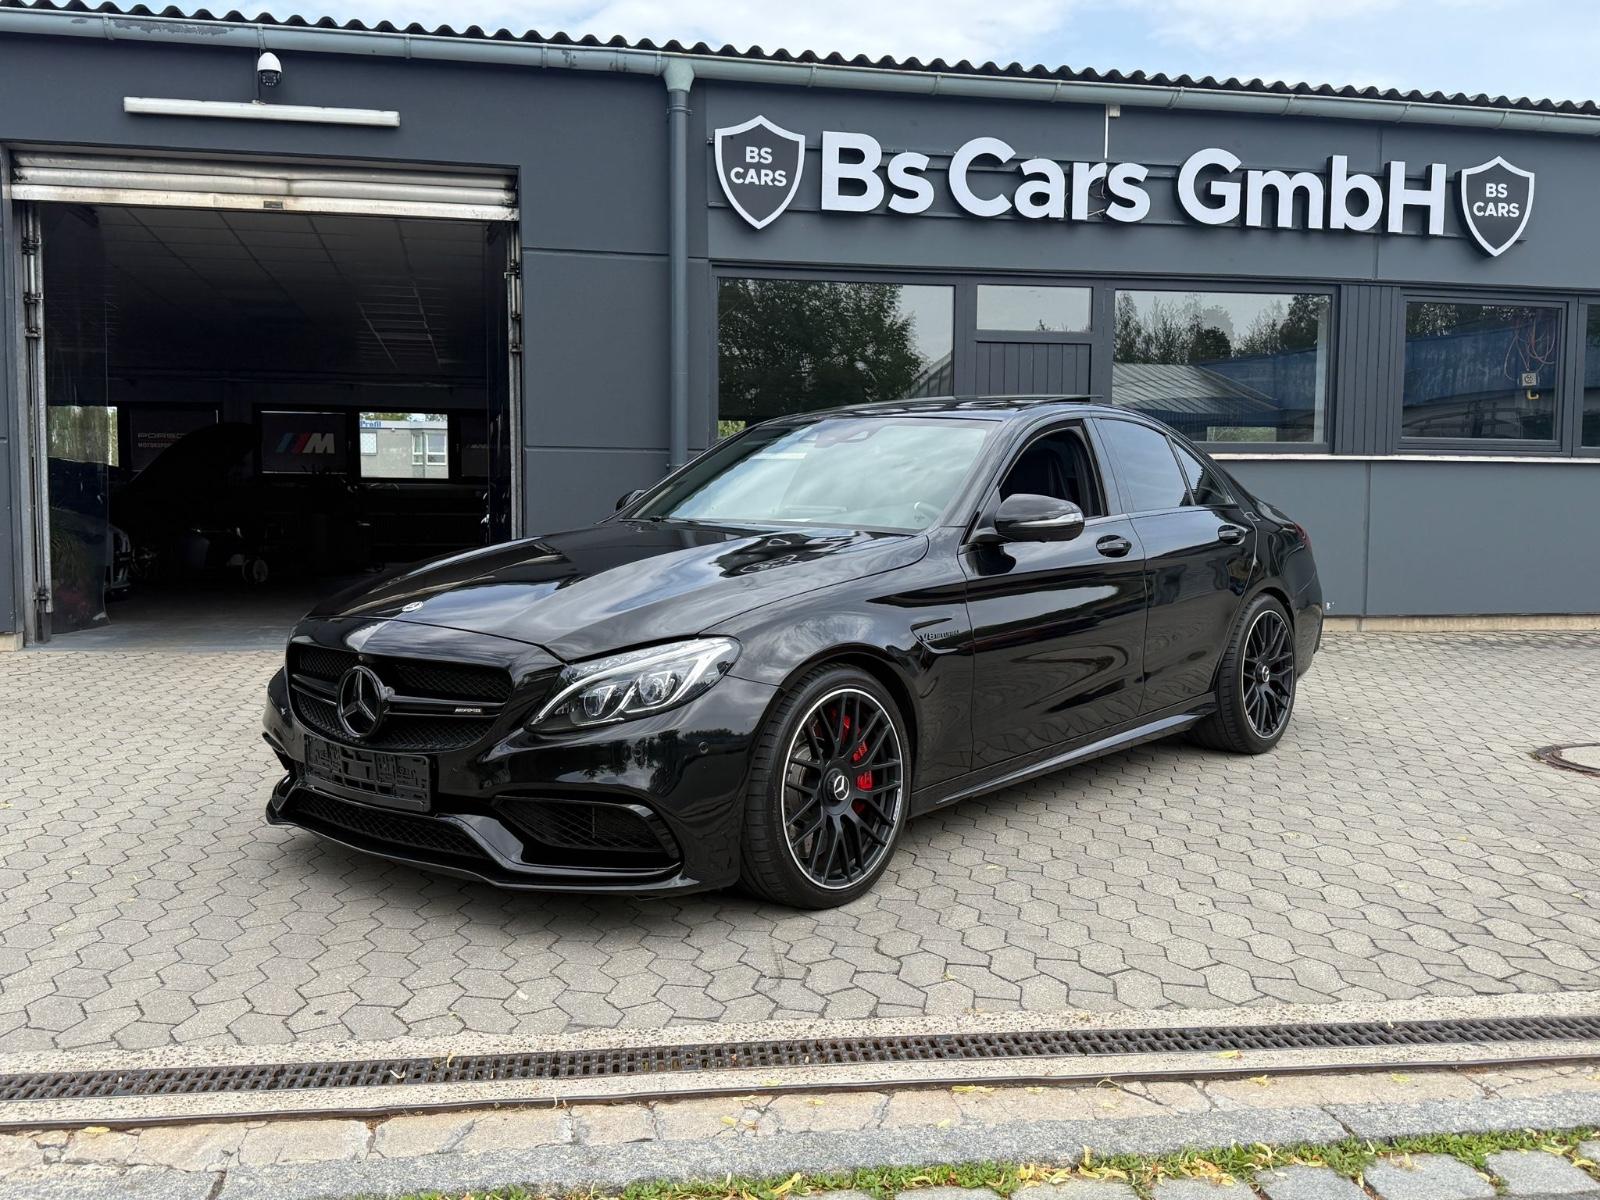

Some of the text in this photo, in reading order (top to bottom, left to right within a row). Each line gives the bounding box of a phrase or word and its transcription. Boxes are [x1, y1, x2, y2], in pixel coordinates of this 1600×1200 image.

[745, 146, 773, 164] BS
[730, 166, 787, 187] CARS
[821, 130, 1447, 236] Bs Cars GmbH
[1485, 182, 1508, 198] BS
[1472, 201, 1520, 218] CARS
